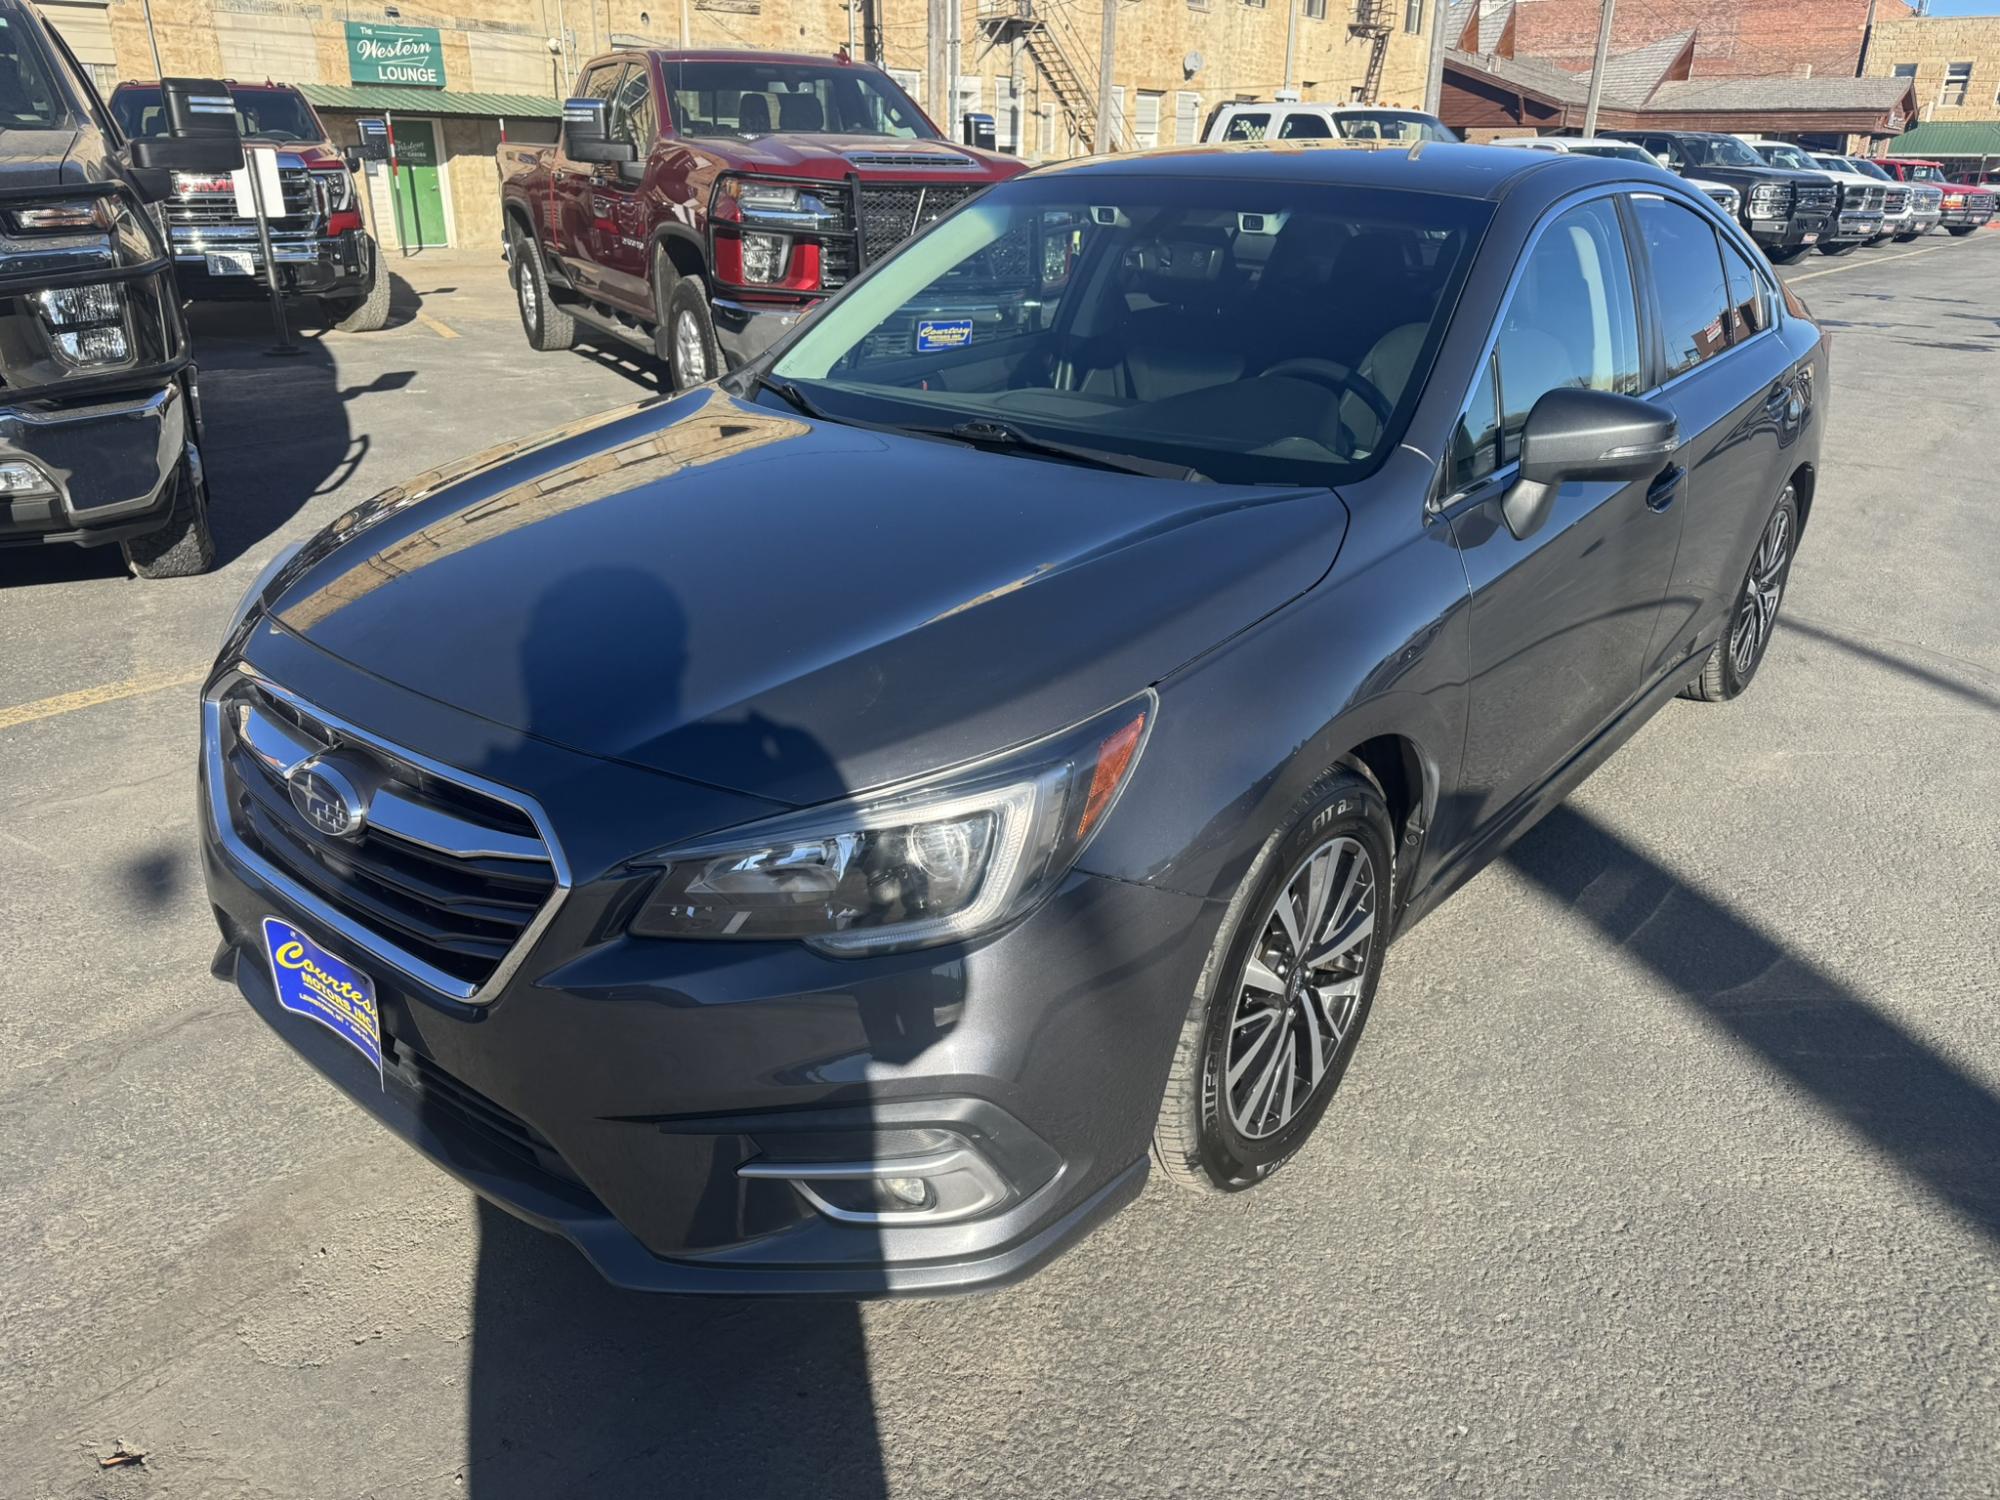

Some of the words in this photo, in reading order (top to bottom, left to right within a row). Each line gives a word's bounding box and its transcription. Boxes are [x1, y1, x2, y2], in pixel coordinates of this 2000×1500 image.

[360, 26, 373, 35] The
[356, 37, 432, 60] Western
[378, 66, 437, 82] LOUNGE
[301, 970, 352, 1011] MOTORS
